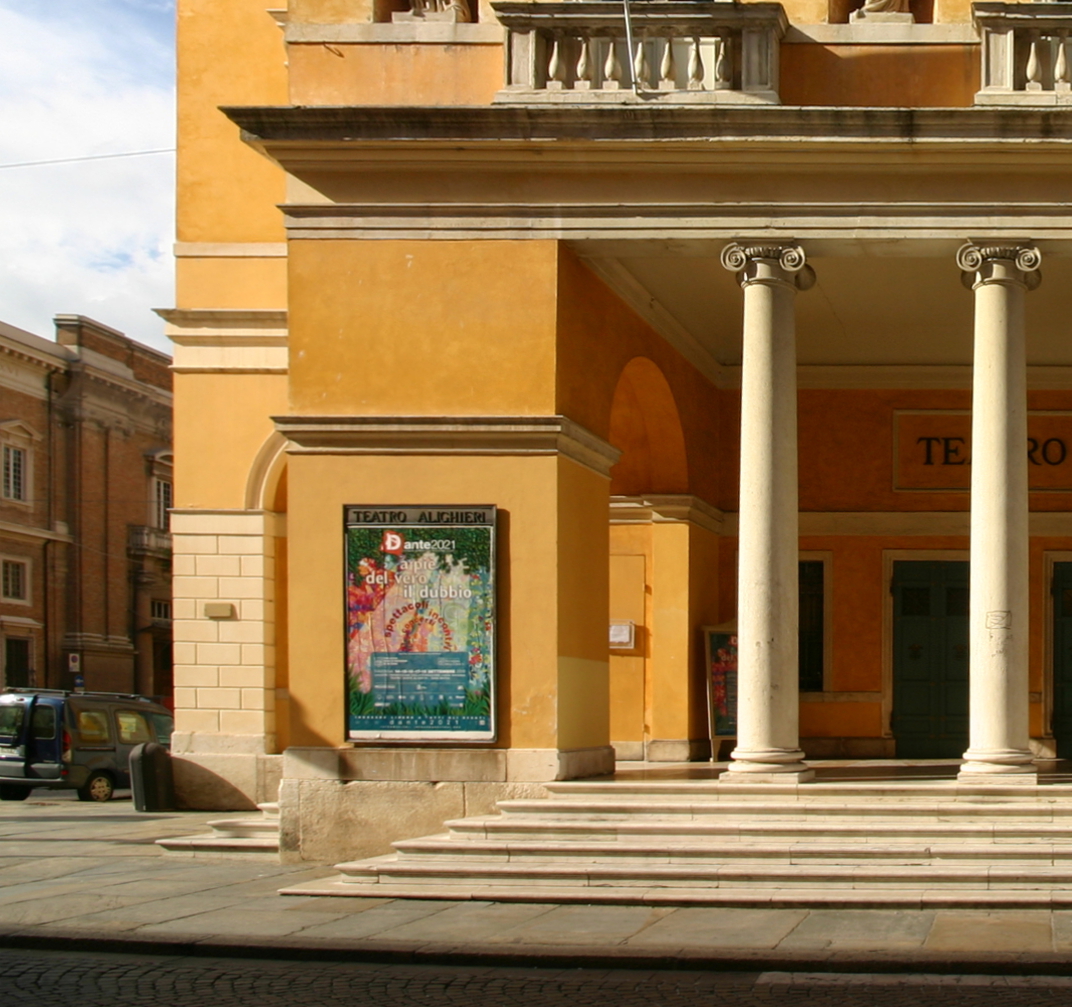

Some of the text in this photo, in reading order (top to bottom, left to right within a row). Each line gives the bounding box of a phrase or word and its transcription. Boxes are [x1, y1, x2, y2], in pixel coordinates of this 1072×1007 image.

[917, 437, 1068, 467] TERO
[353, 510, 486, 523] TEATRO ALIGHIERI
[385, 532, 456, 551] Dante2021
[366, 571, 427, 584] del vero
[403, 586, 472, 599] il dubbio
[384, 600, 430, 638] spettacoli
[428, 610, 454, 651] incontri
